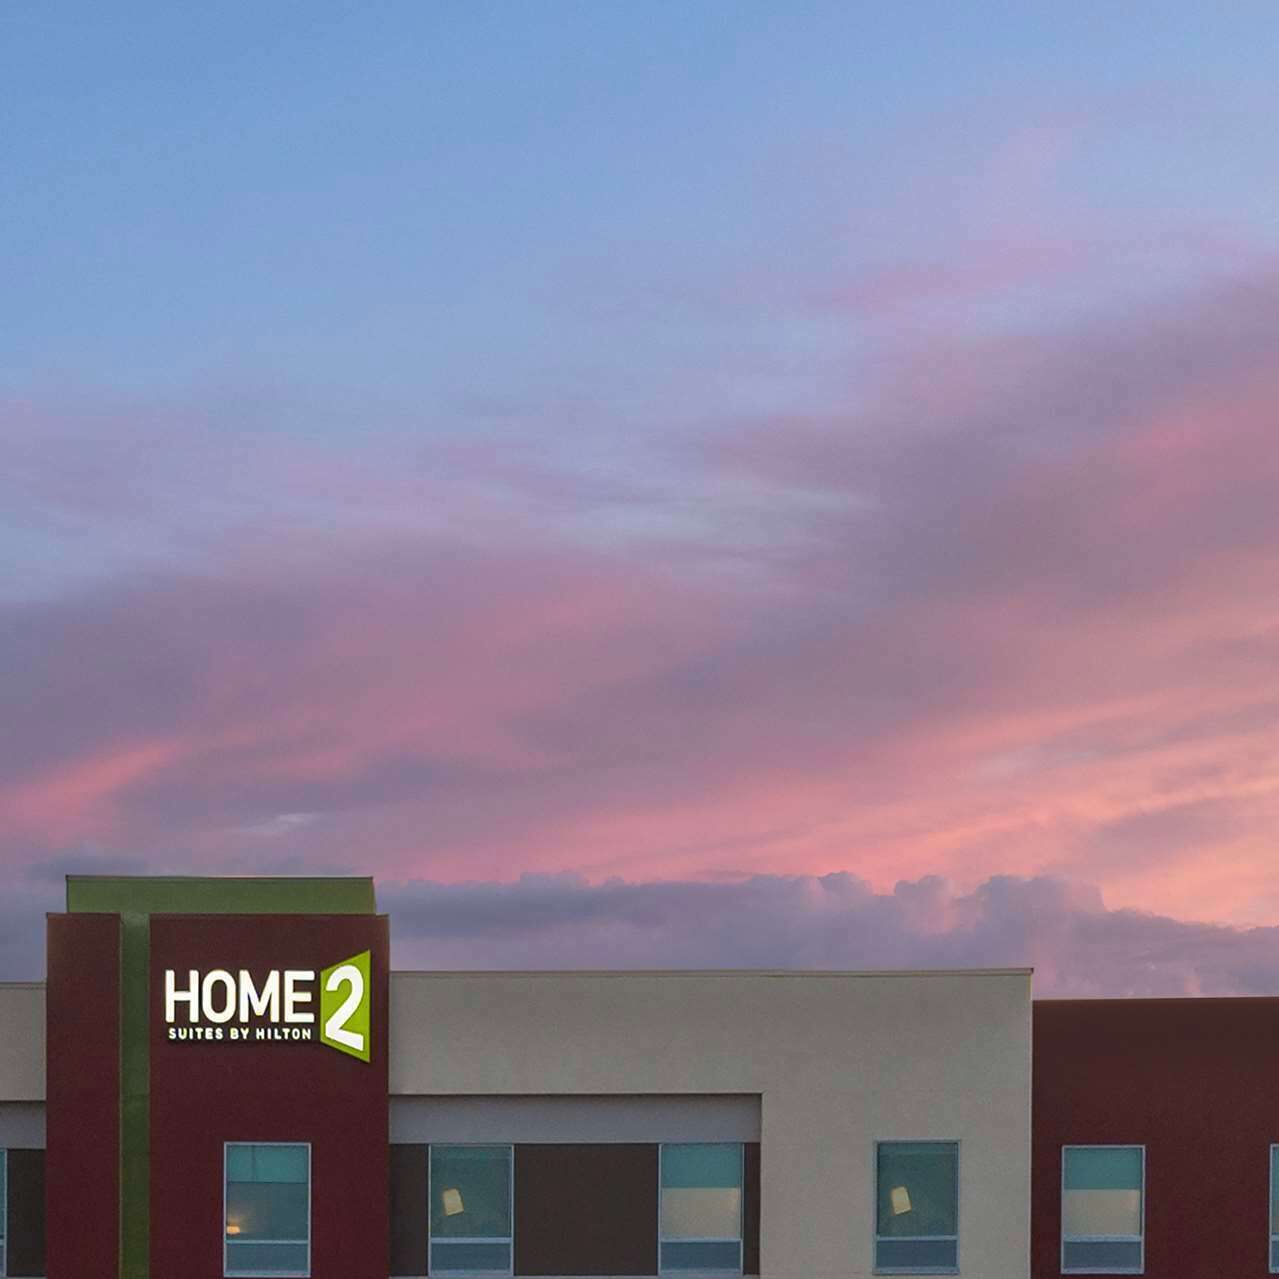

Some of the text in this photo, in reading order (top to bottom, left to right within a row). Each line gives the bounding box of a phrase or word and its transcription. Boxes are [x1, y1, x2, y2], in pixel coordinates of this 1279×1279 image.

[164, 964, 365, 1052] HOME 2
[168, 1027, 312, 1040] SUITES BY HILTON
